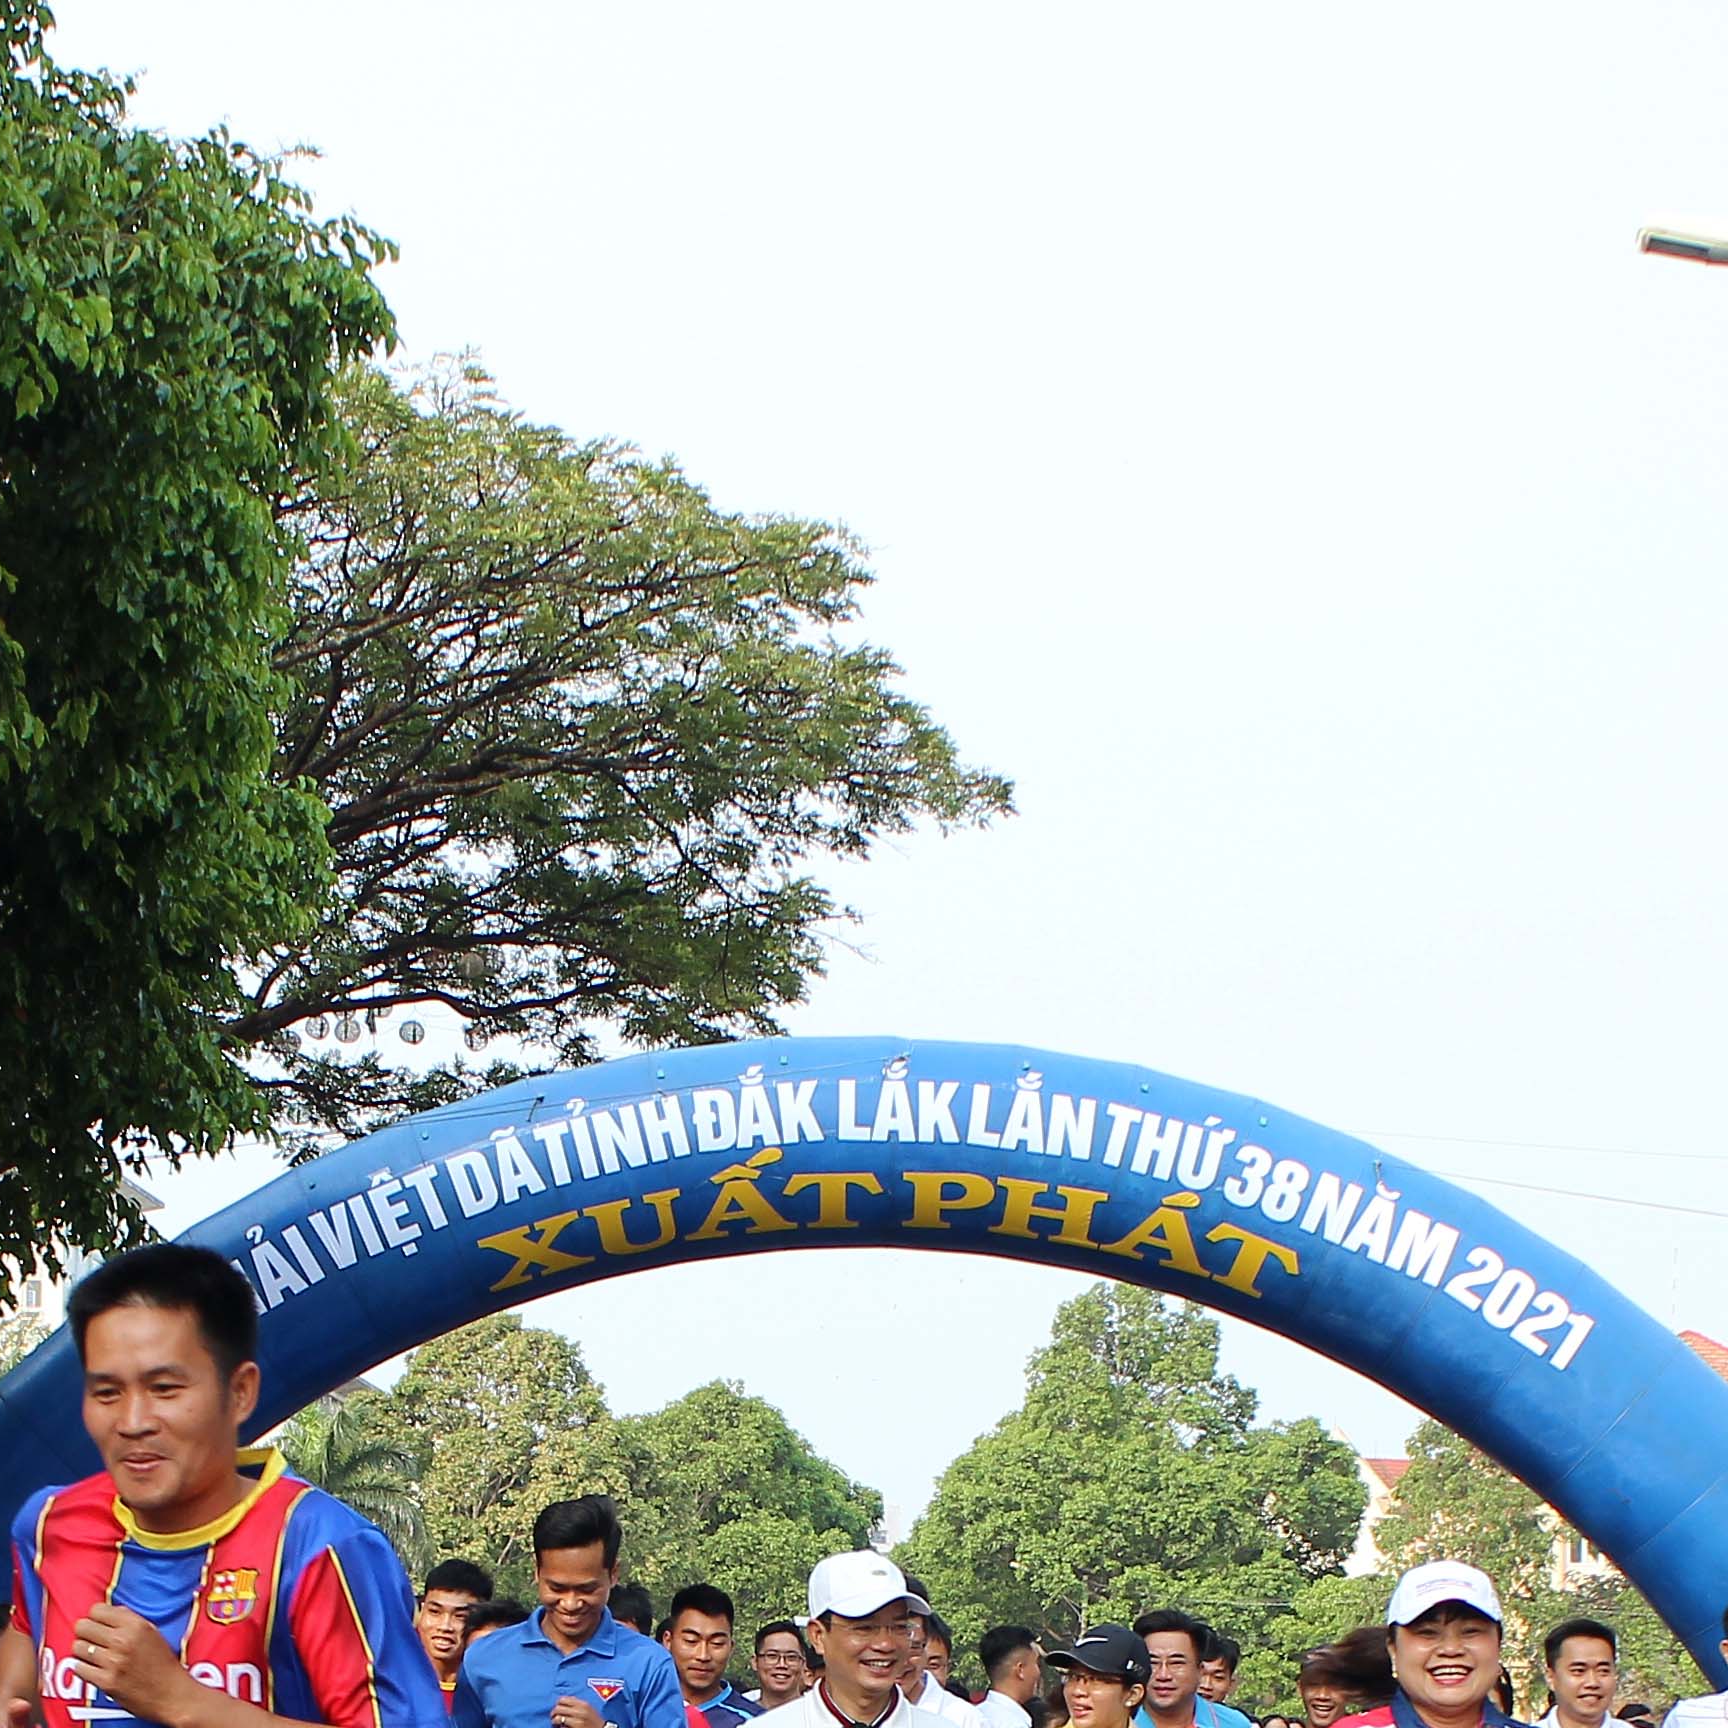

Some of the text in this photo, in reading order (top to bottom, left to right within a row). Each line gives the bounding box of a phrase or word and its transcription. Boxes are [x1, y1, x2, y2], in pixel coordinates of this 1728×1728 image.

[230, 1224, 326, 1316] ẢI
[307, 1166, 449, 1271] VIỆT
[445, 1126, 548, 1220] DÃ
[532, 1089, 692, 1188] TỈNH
[692, 1064, 825, 1154] ĐẮK
[837, 1056, 961, 1145] LẮK
[1101, 1101, 1236, 1192] THỨ
[1222, 1143, 1311, 1224] 38
[1298, 1170, 1462, 1288] NĂM
[1443, 1244, 1597, 1372] 2021
[477, 1146, 1301, 1299] XUẤT PHÁT
[42, 1647, 263, 1703] Raen
